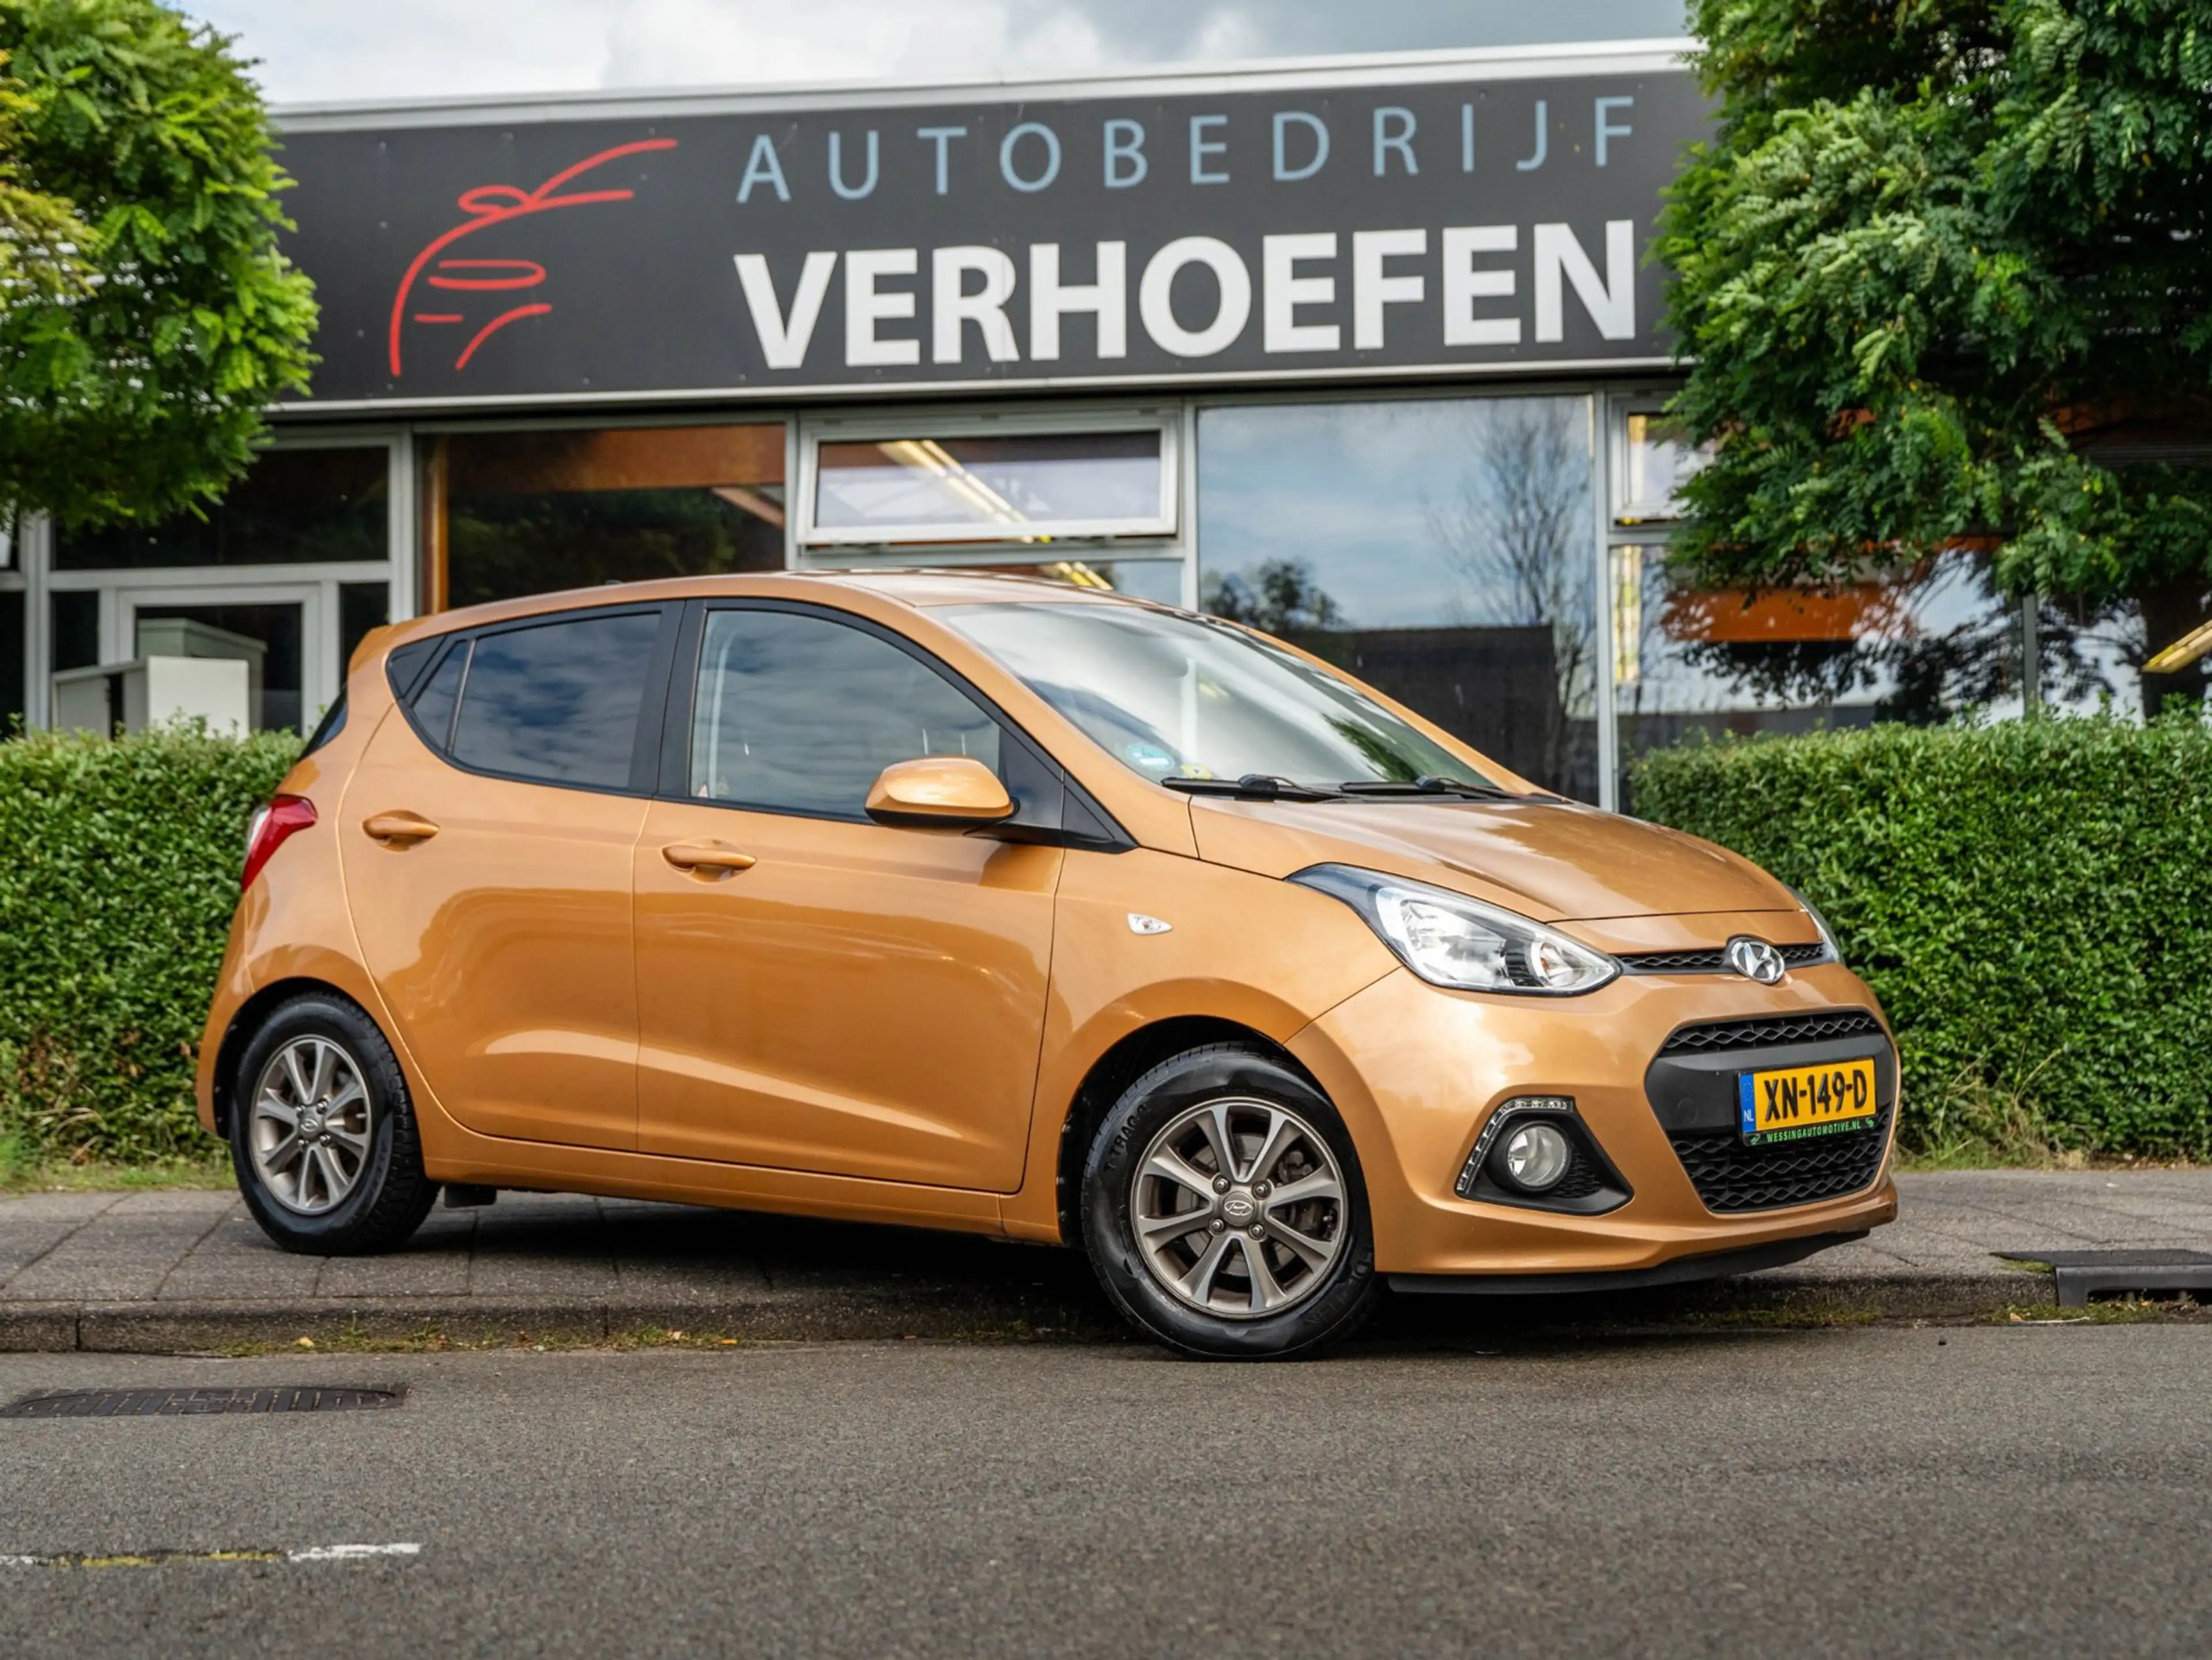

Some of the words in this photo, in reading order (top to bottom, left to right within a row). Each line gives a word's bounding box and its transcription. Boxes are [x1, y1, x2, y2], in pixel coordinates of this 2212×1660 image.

[737, 96, 1633, 204] AUTOBEDRIJF
[734, 220, 1636, 370] VERHOEFEN
[1743, 1110, 1754, 1122] NL
[1764, 1069, 1867, 1122] XN-149-D
[1766, 1120, 1860, 1142] WESSINGAUTOMOTIVE.NL
